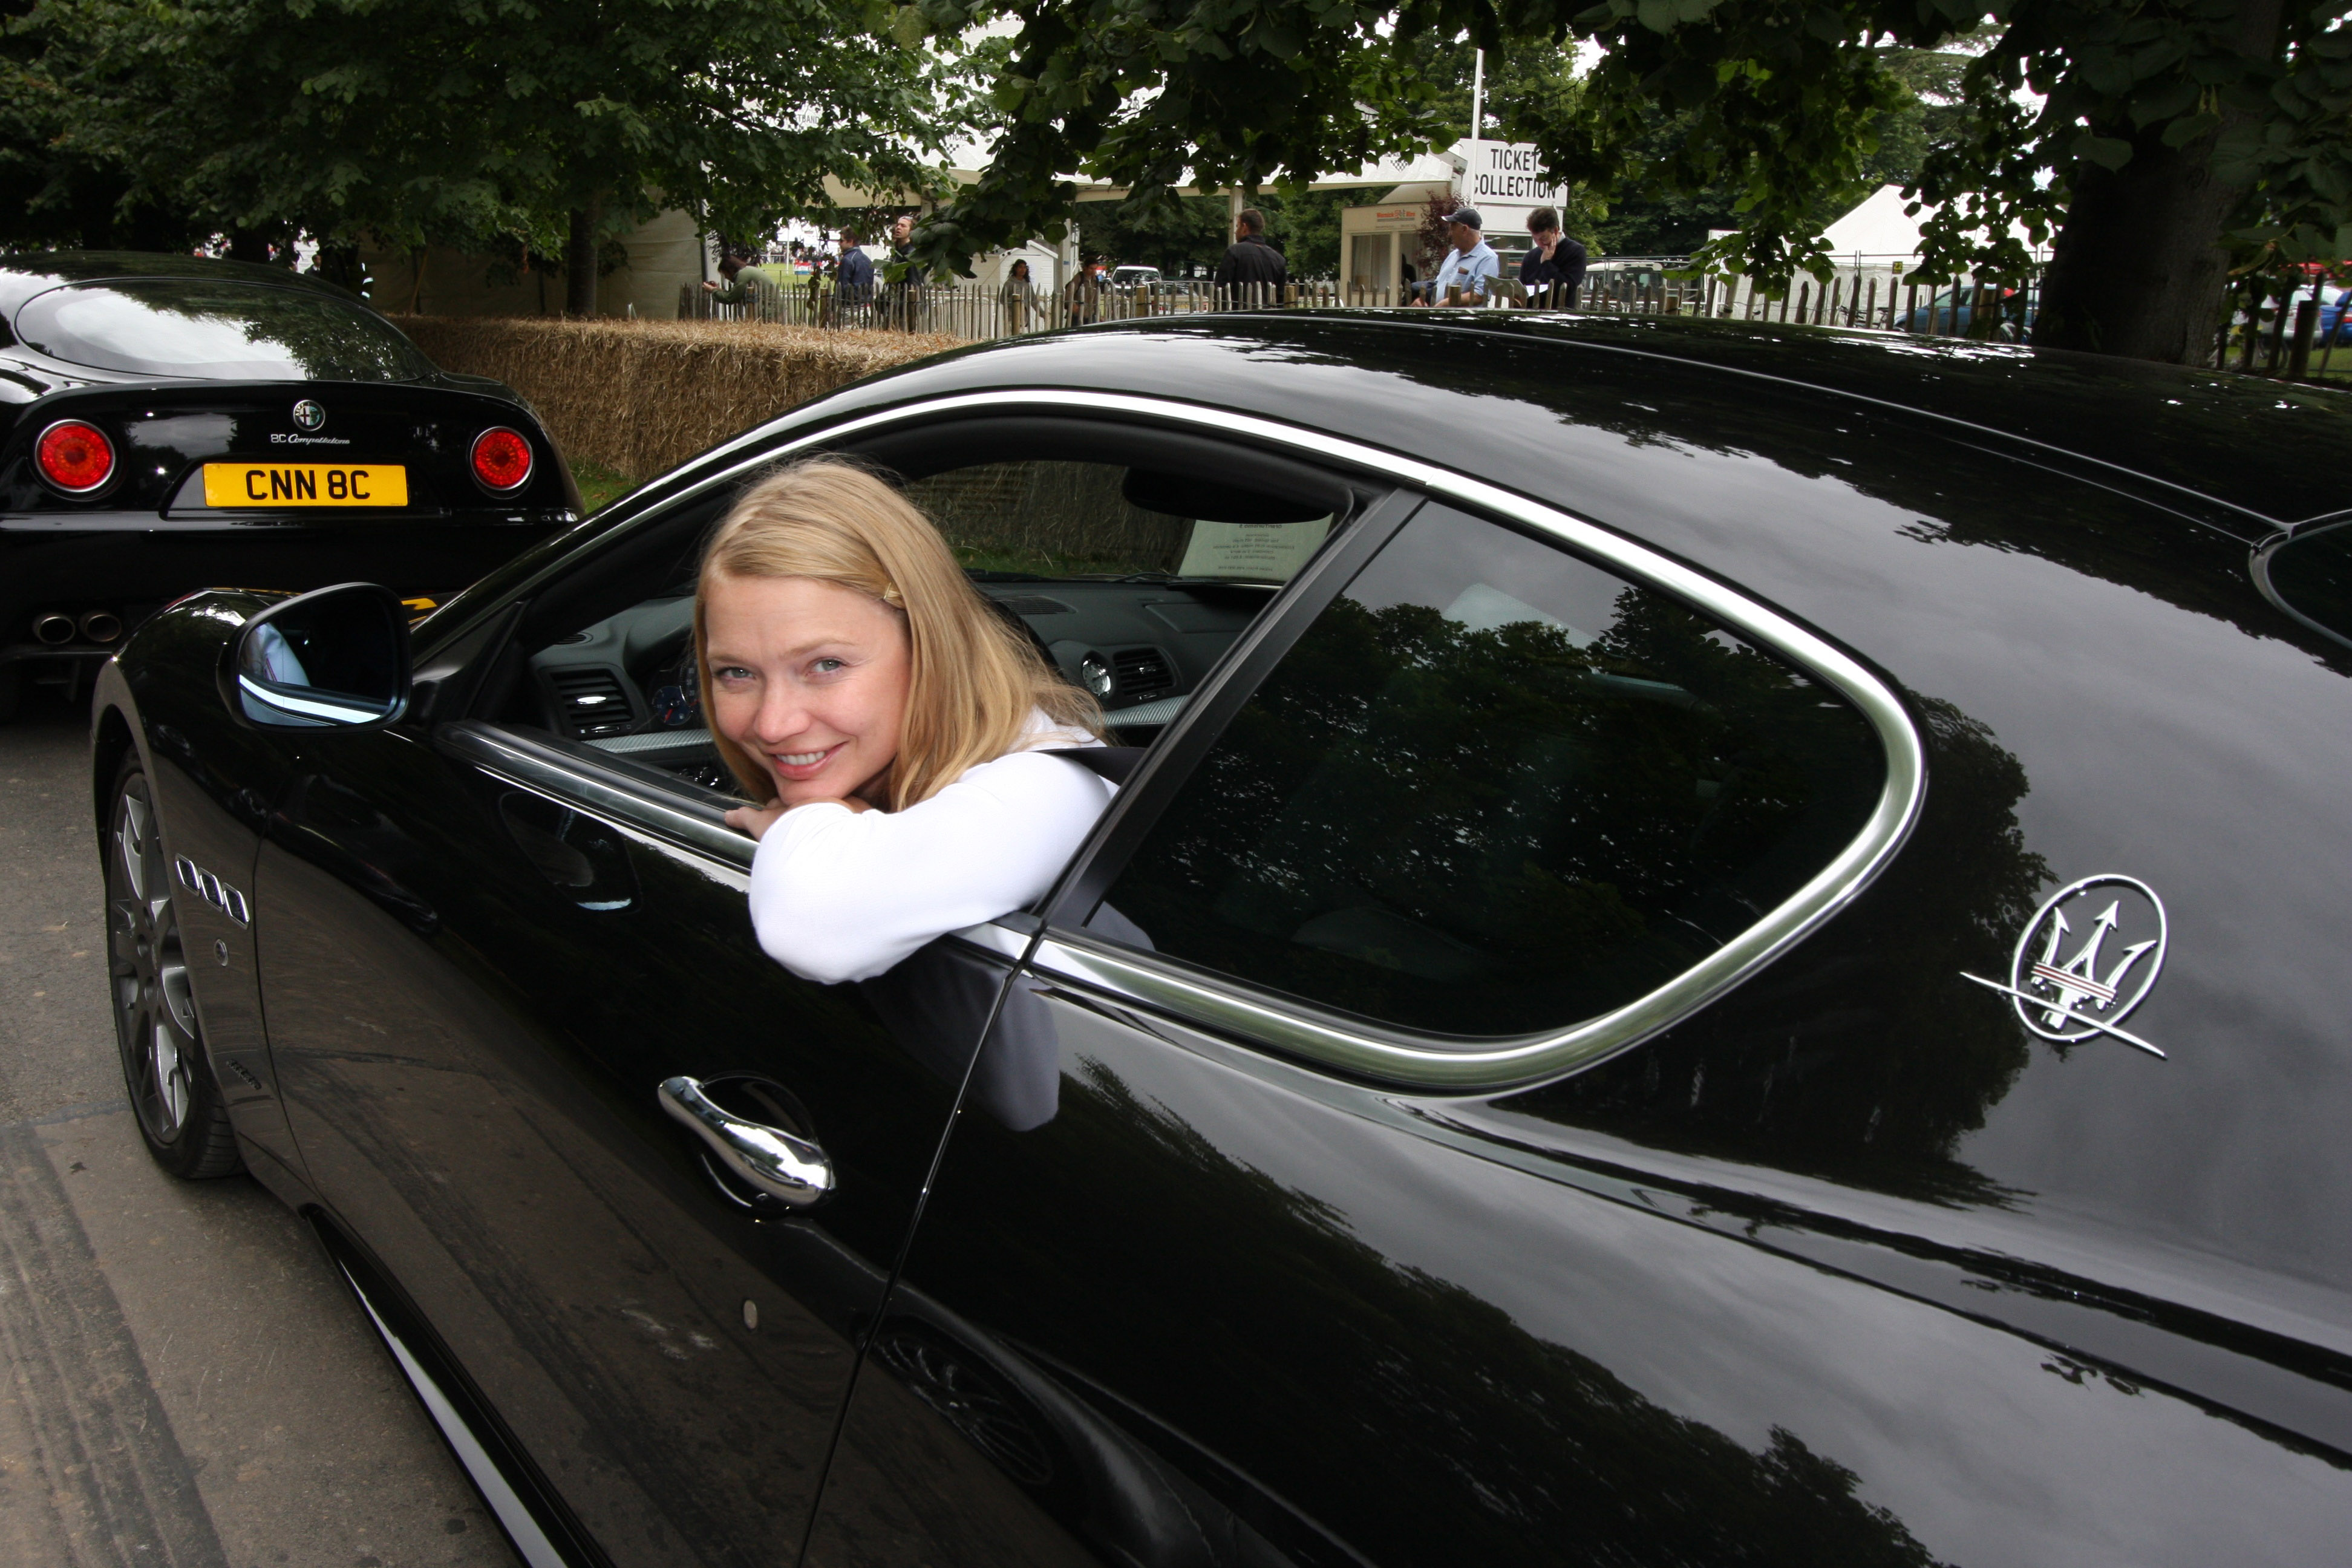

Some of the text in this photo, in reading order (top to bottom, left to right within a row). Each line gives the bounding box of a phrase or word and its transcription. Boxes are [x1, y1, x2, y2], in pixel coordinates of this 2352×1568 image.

[270, 434, 350, 445] 8C Competizione
[246, 470, 370, 500] CNN 8C
